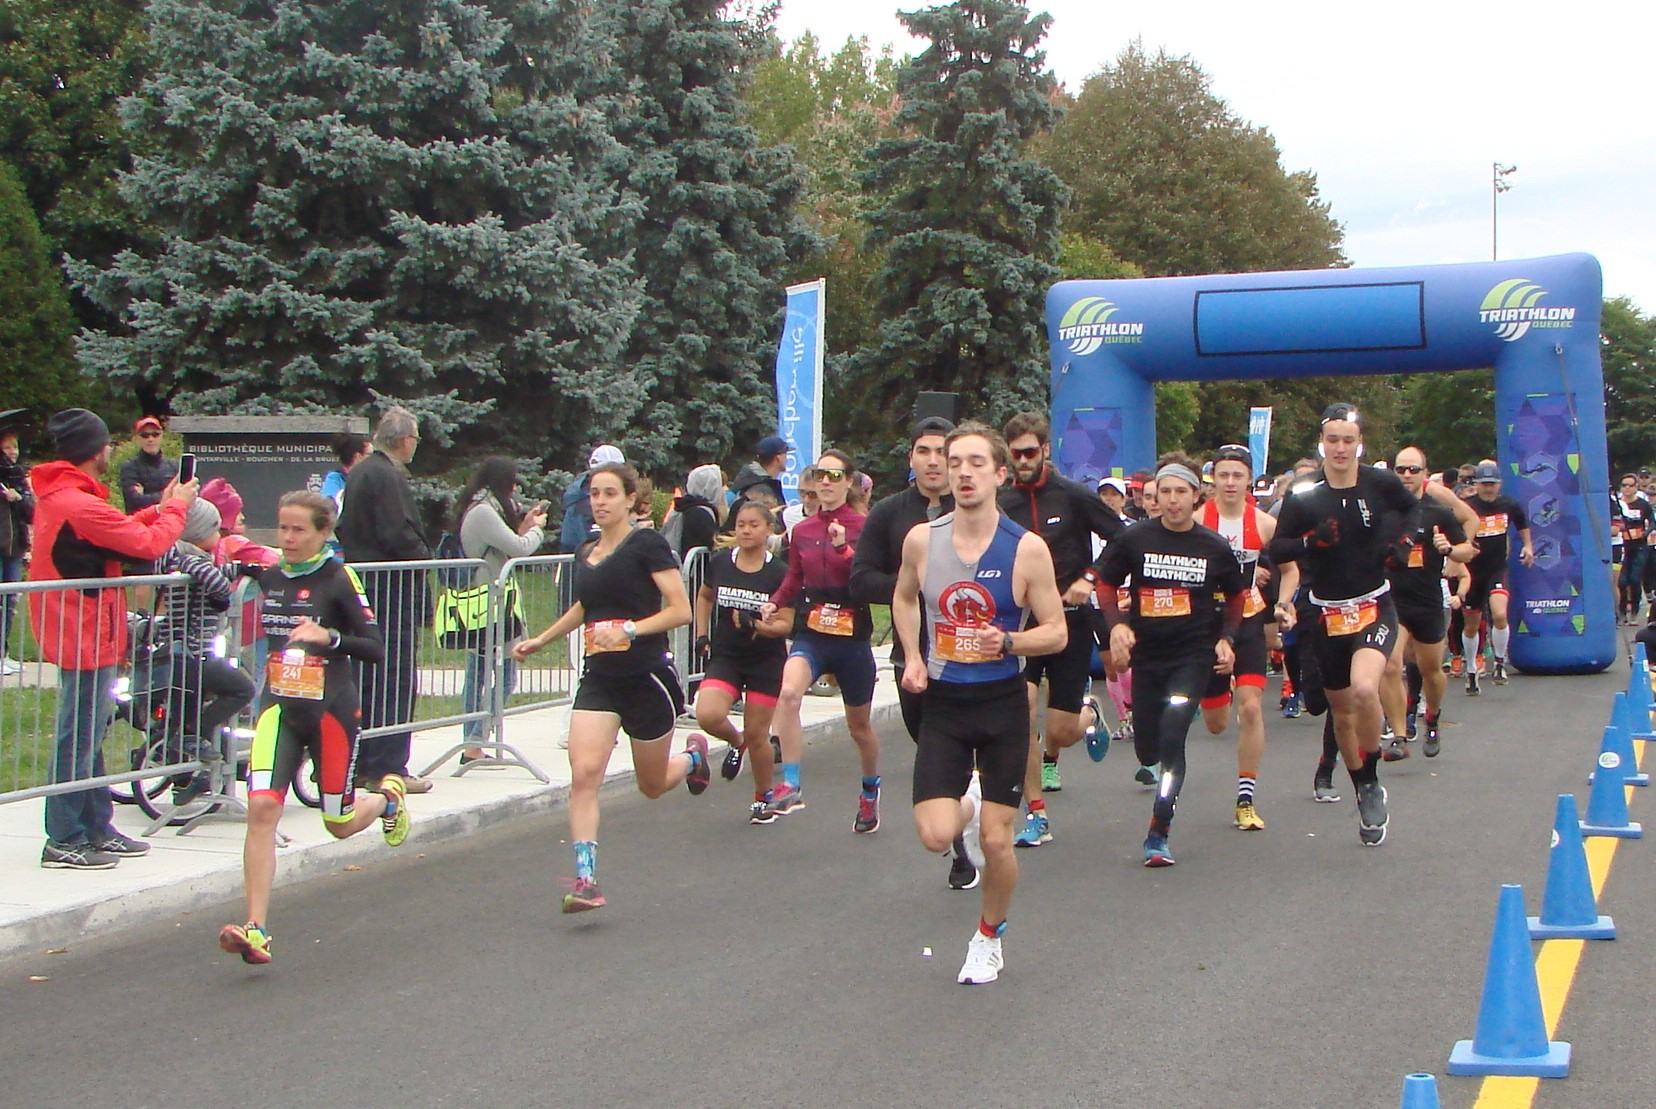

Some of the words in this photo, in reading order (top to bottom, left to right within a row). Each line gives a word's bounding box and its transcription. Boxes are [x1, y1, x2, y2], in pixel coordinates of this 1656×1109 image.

[1479, 307, 1576, 323] TRIATHLON
[1059, 323, 1144, 340] TRIATHLON
[190, 443, 273, 454] BIBLIOTHÈQUE
[276, 445, 333, 453] MUNICIPA
[1144, 553, 1207, 569] TRIATHLON
[1143, 567, 1206, 583] DUATHLON
[718, 586, 769, 602] TRIATHLON
[718, 598, 763, 612] DUATHLO
[1154, 597, 1174, 608] 270
[1525, 600, 1570, 608] TRIATHLON
[261, 613, 322, 625] GARNEU
[819, 616, 838, 627] 202
[1343, 612, 1360, 625] 143
[1375, 623, 1389, 646] 2XU
[955, 638, 980, 651] 265
[282, 666, 302, 680] 241
